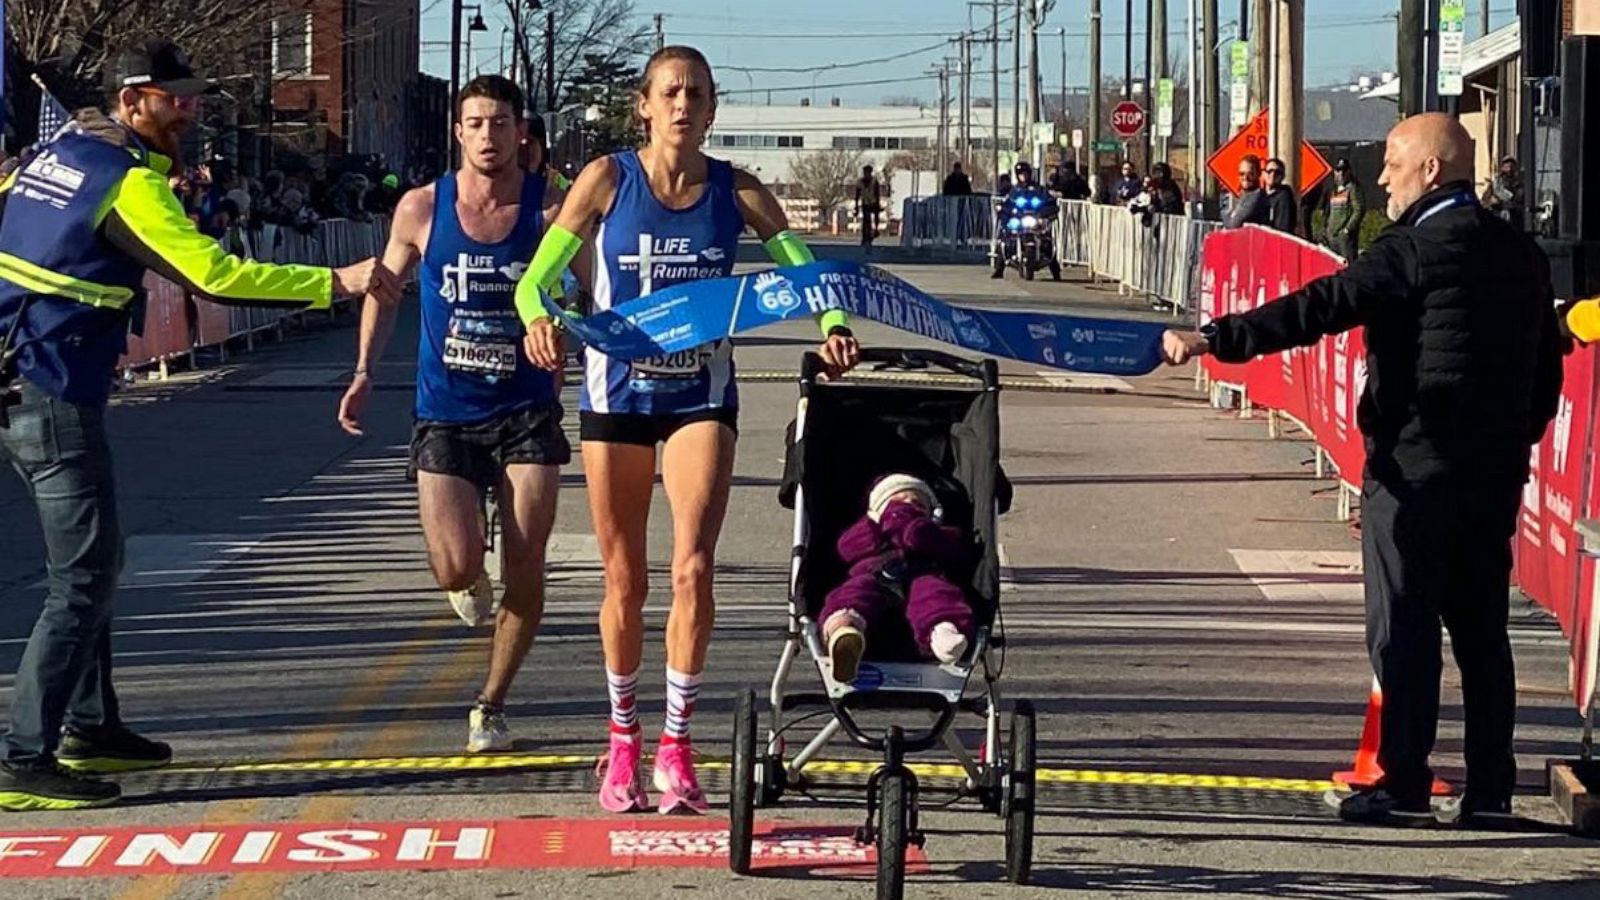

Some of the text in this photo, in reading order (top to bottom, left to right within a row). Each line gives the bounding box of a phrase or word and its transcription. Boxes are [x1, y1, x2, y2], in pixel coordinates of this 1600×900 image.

[1113, 111, 1142, 125] STOP
[1246, 135, 1268, 149] RO
[654, 238, 691, 254] LIFE
[468, 255, 495, 268] LIFE
[653, 263, 723, 279] Runners
[469, 280, 515, 293] Runner
[819, 272, 857, 286] FIRST
[860, 277, 897, 298] PLACE
[762, 289, 794, 309] 66
[804, 284, 959, 346] HALF MARATHON
[0, 827, 494, 868] FINISH
